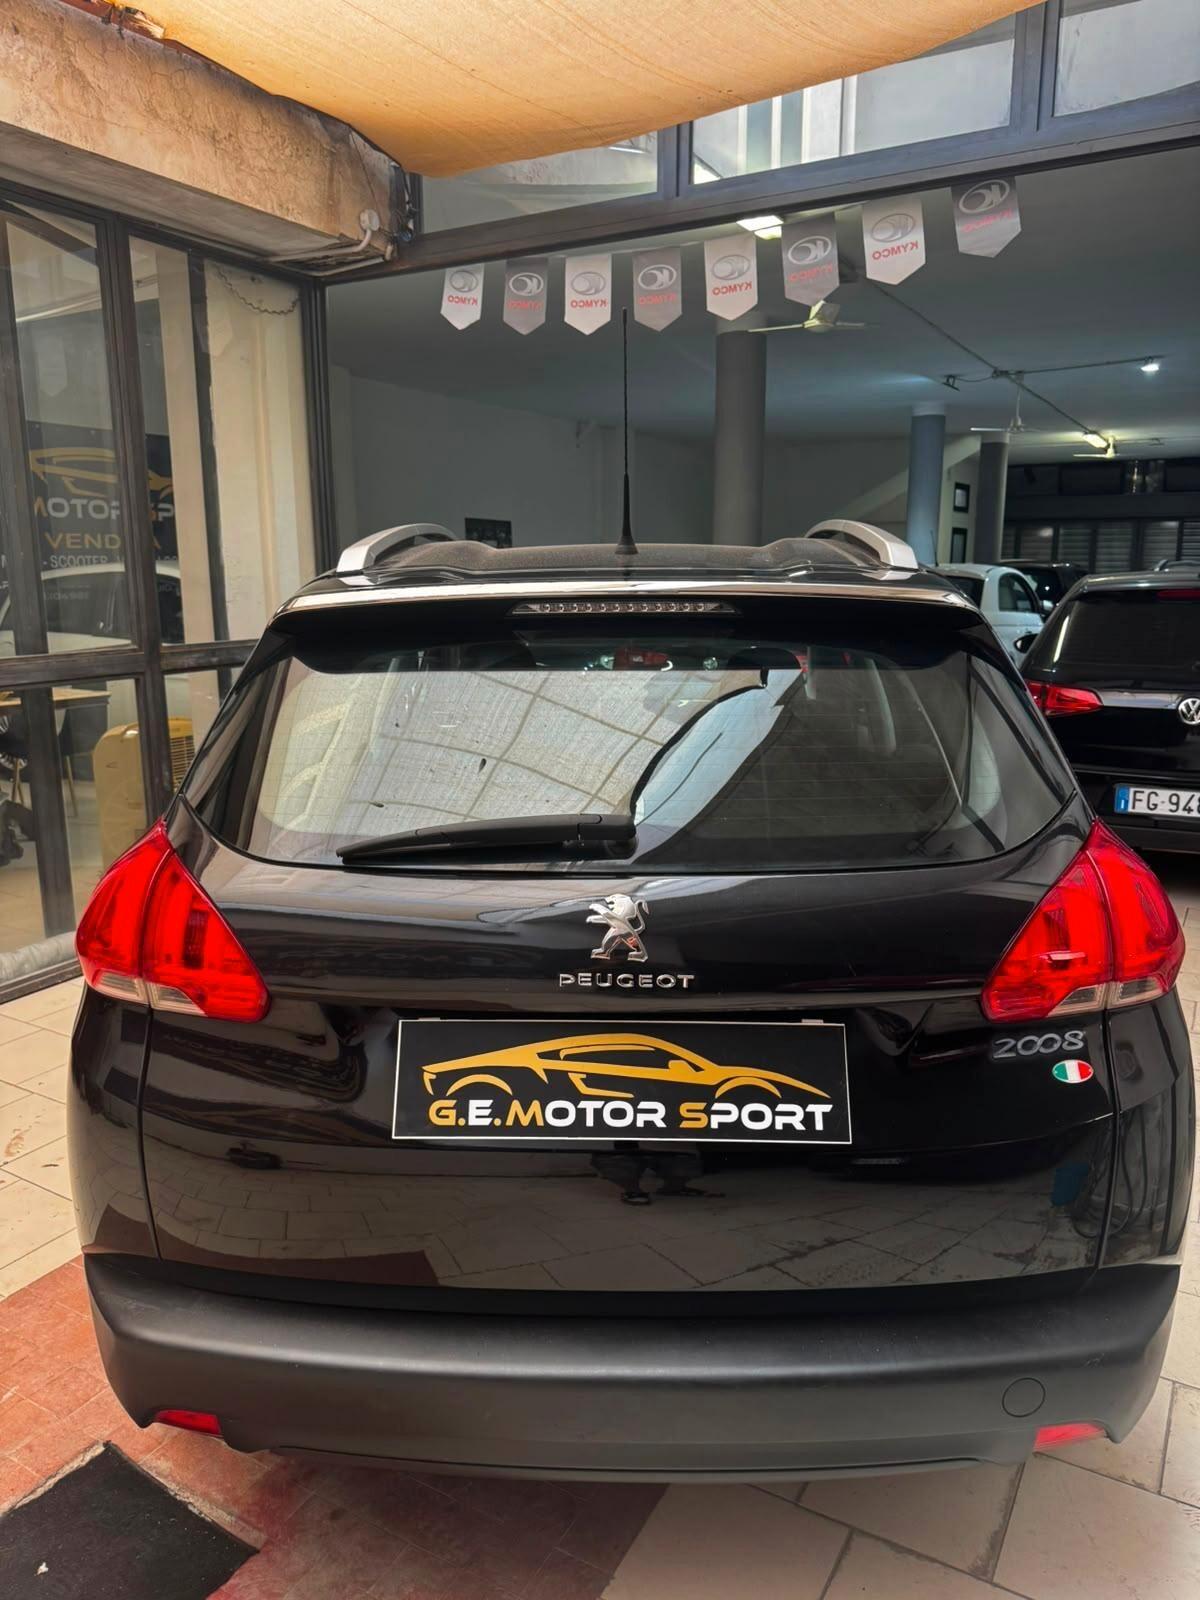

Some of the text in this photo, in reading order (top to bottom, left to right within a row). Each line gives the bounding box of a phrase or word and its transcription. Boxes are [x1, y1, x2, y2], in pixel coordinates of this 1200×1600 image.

[559, 972, 695, 989] PEUGEOT
[993, 1030, 1085, 1058] 2008
[679, 1101, 833, 1131] SPORT
